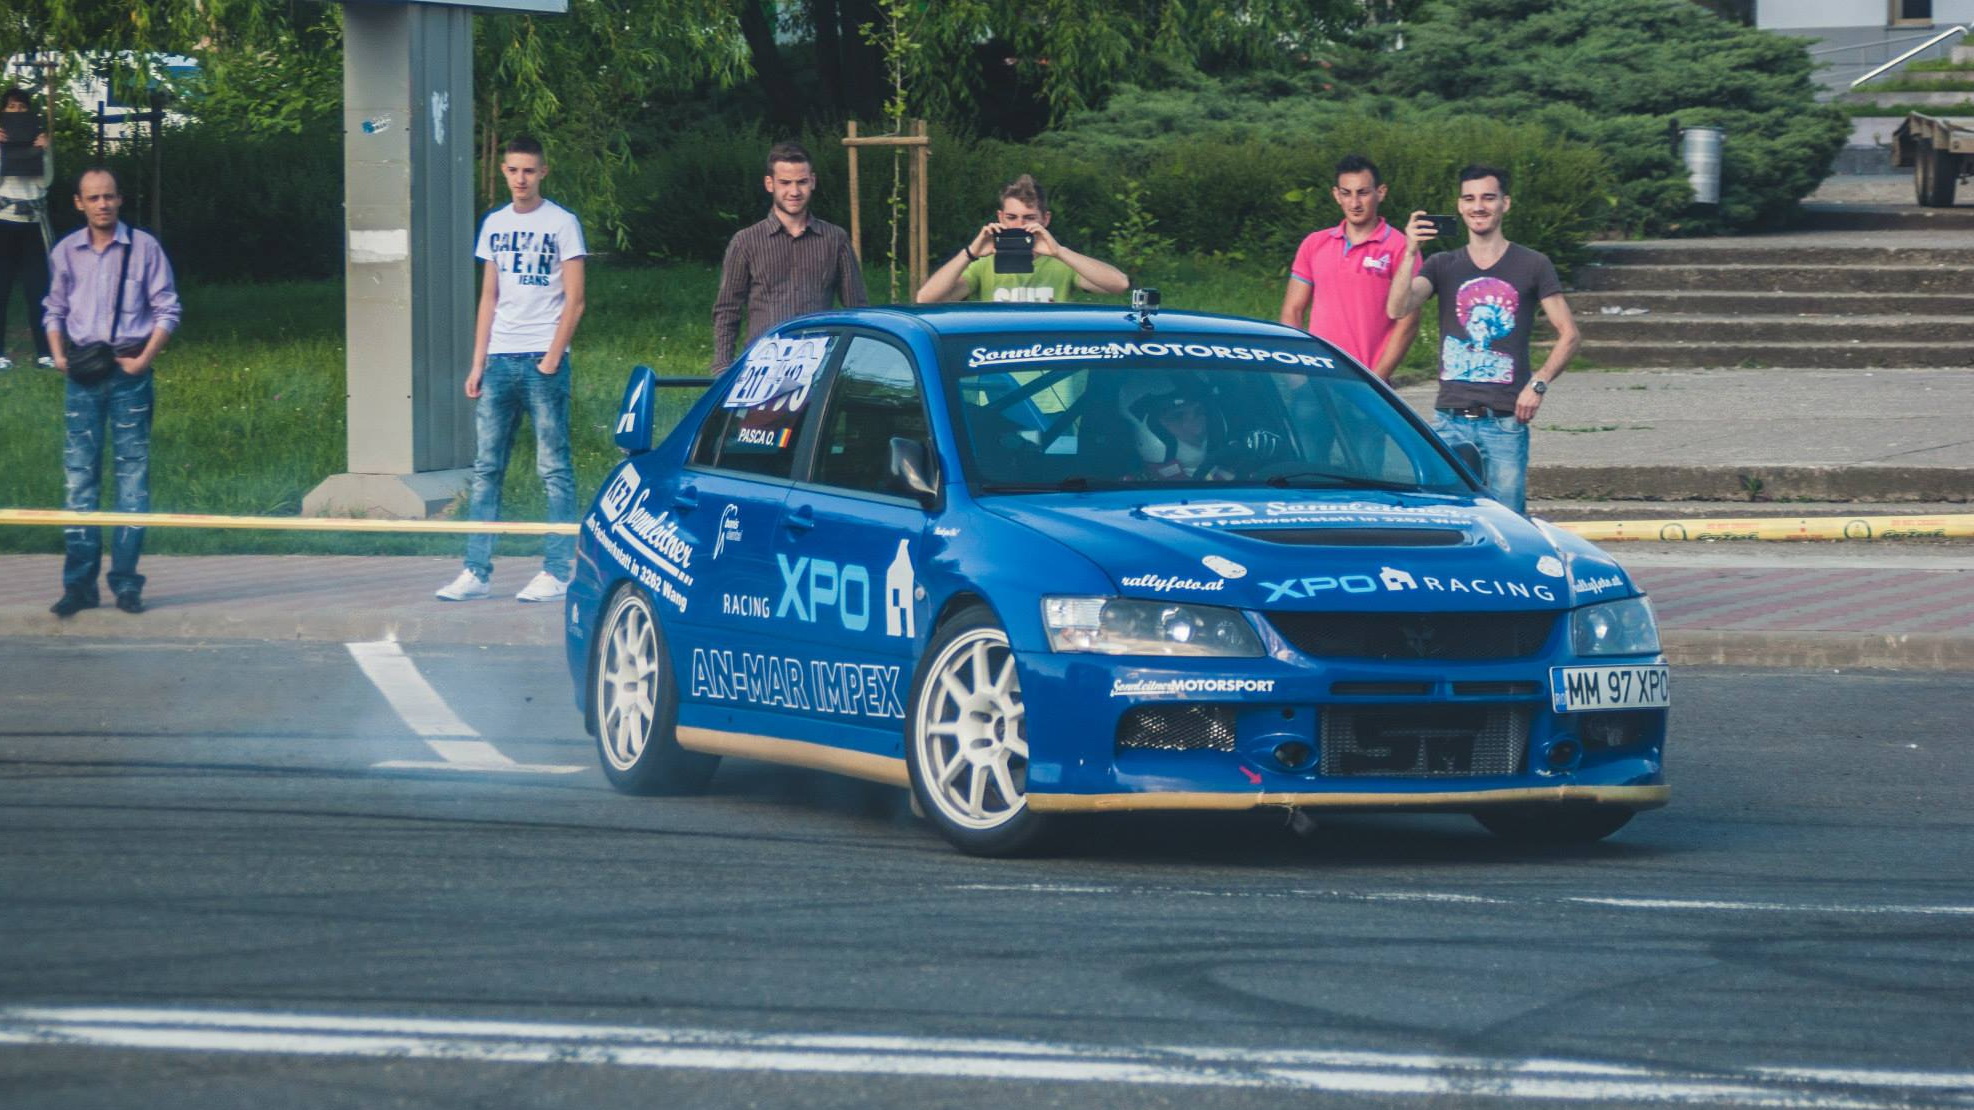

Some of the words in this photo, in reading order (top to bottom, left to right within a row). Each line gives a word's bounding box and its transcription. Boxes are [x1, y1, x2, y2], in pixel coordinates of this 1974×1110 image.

[1112, 343, 1334, 370] MOTORSPORT
[737, 428, 766, 445] PASCA
[639, 565, 663, 592] 3262
[662, 579, 688, 613] Wang
[776, 553, 870, 632] XPO
[1121, 574, 1225, 592] rallyfoto.at
[1258, 576, 1377, 603] XPO
[1423, 576, 1556, 601] RACING
[723, 593, 770, 619] RACING
[692, 648, 811, 710] AN-MAR
[810, 660, 906, 719] IMPEX
[1171, 679, 1275, 692] MOTORSPORT
[1568, 672, 1600, 705] MM
[1608, 671, 1631, 702] 97
